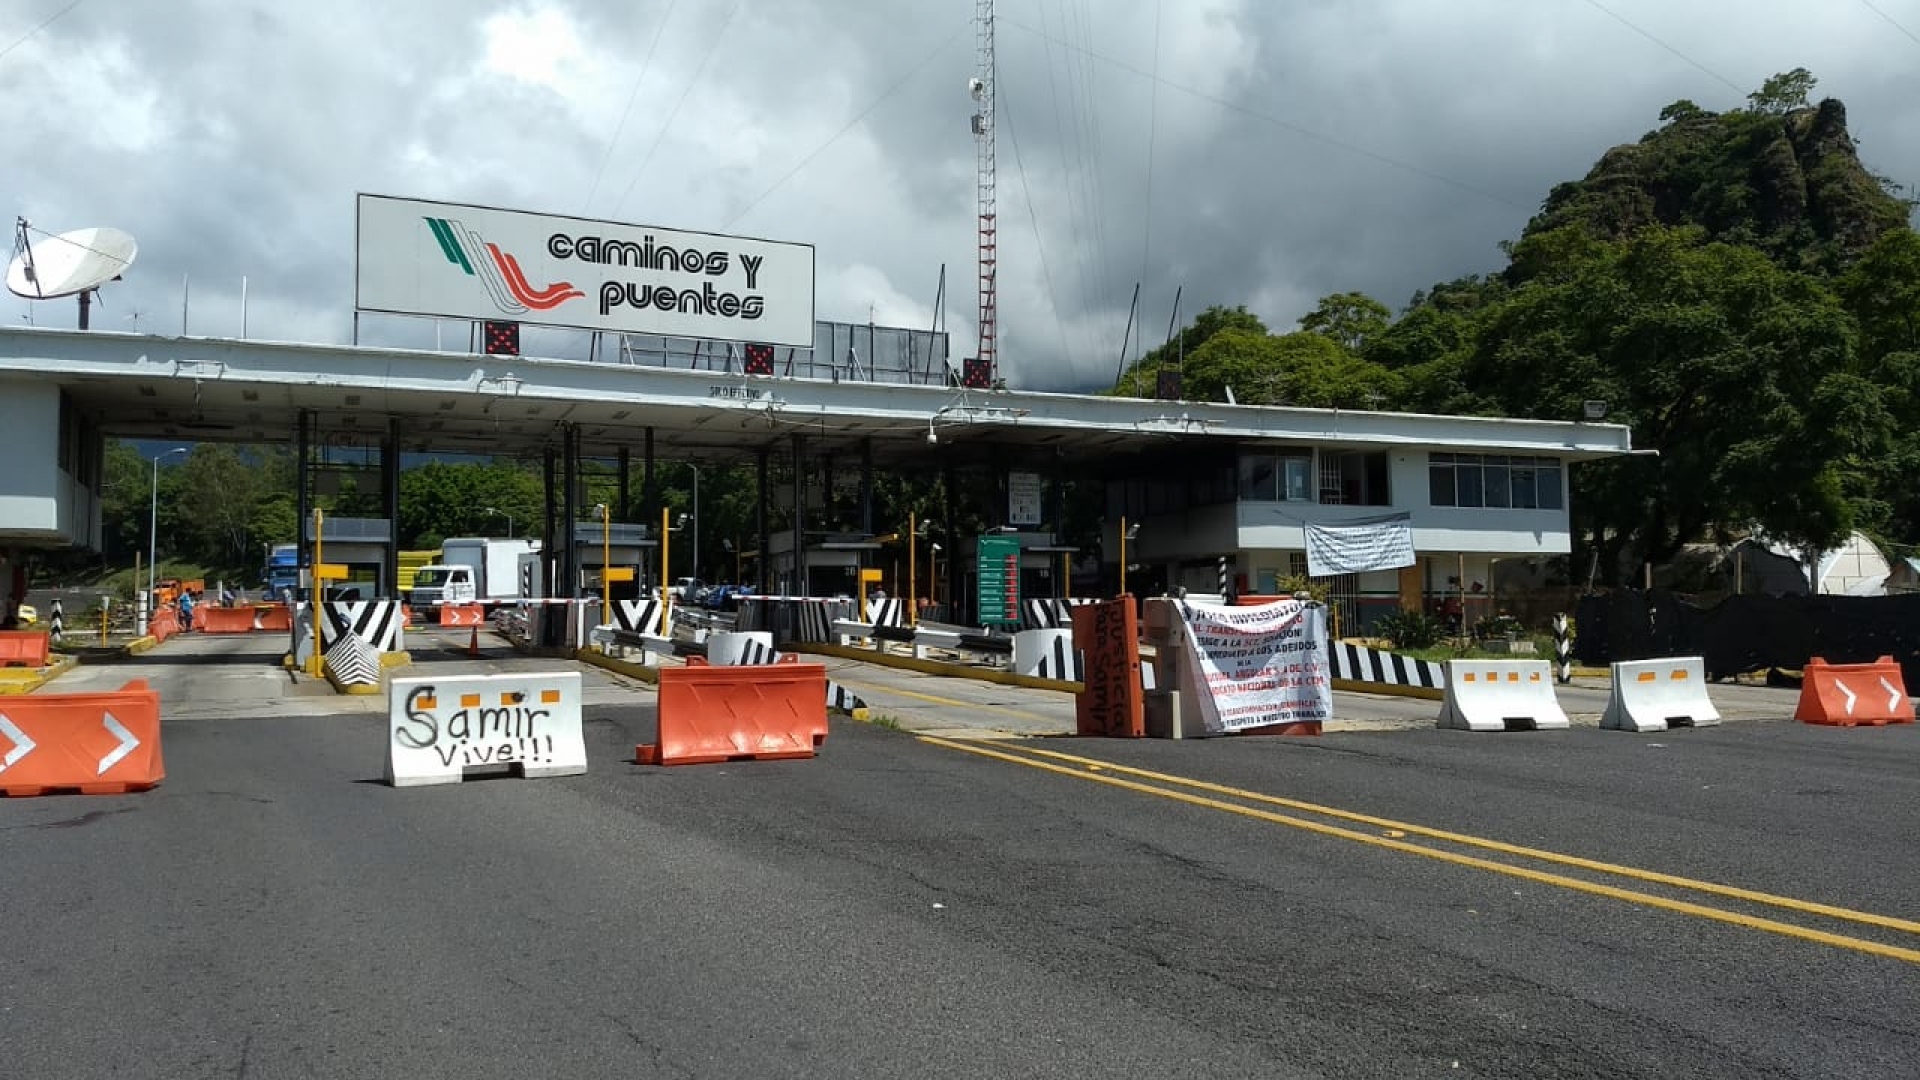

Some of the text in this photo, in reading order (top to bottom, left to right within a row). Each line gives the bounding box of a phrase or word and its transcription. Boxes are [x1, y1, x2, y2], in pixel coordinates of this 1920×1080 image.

[547, 233, 763, 289] caminos Y
[600, 281, 764, 320] puentes
[396, 685, 550, 749] Samir
